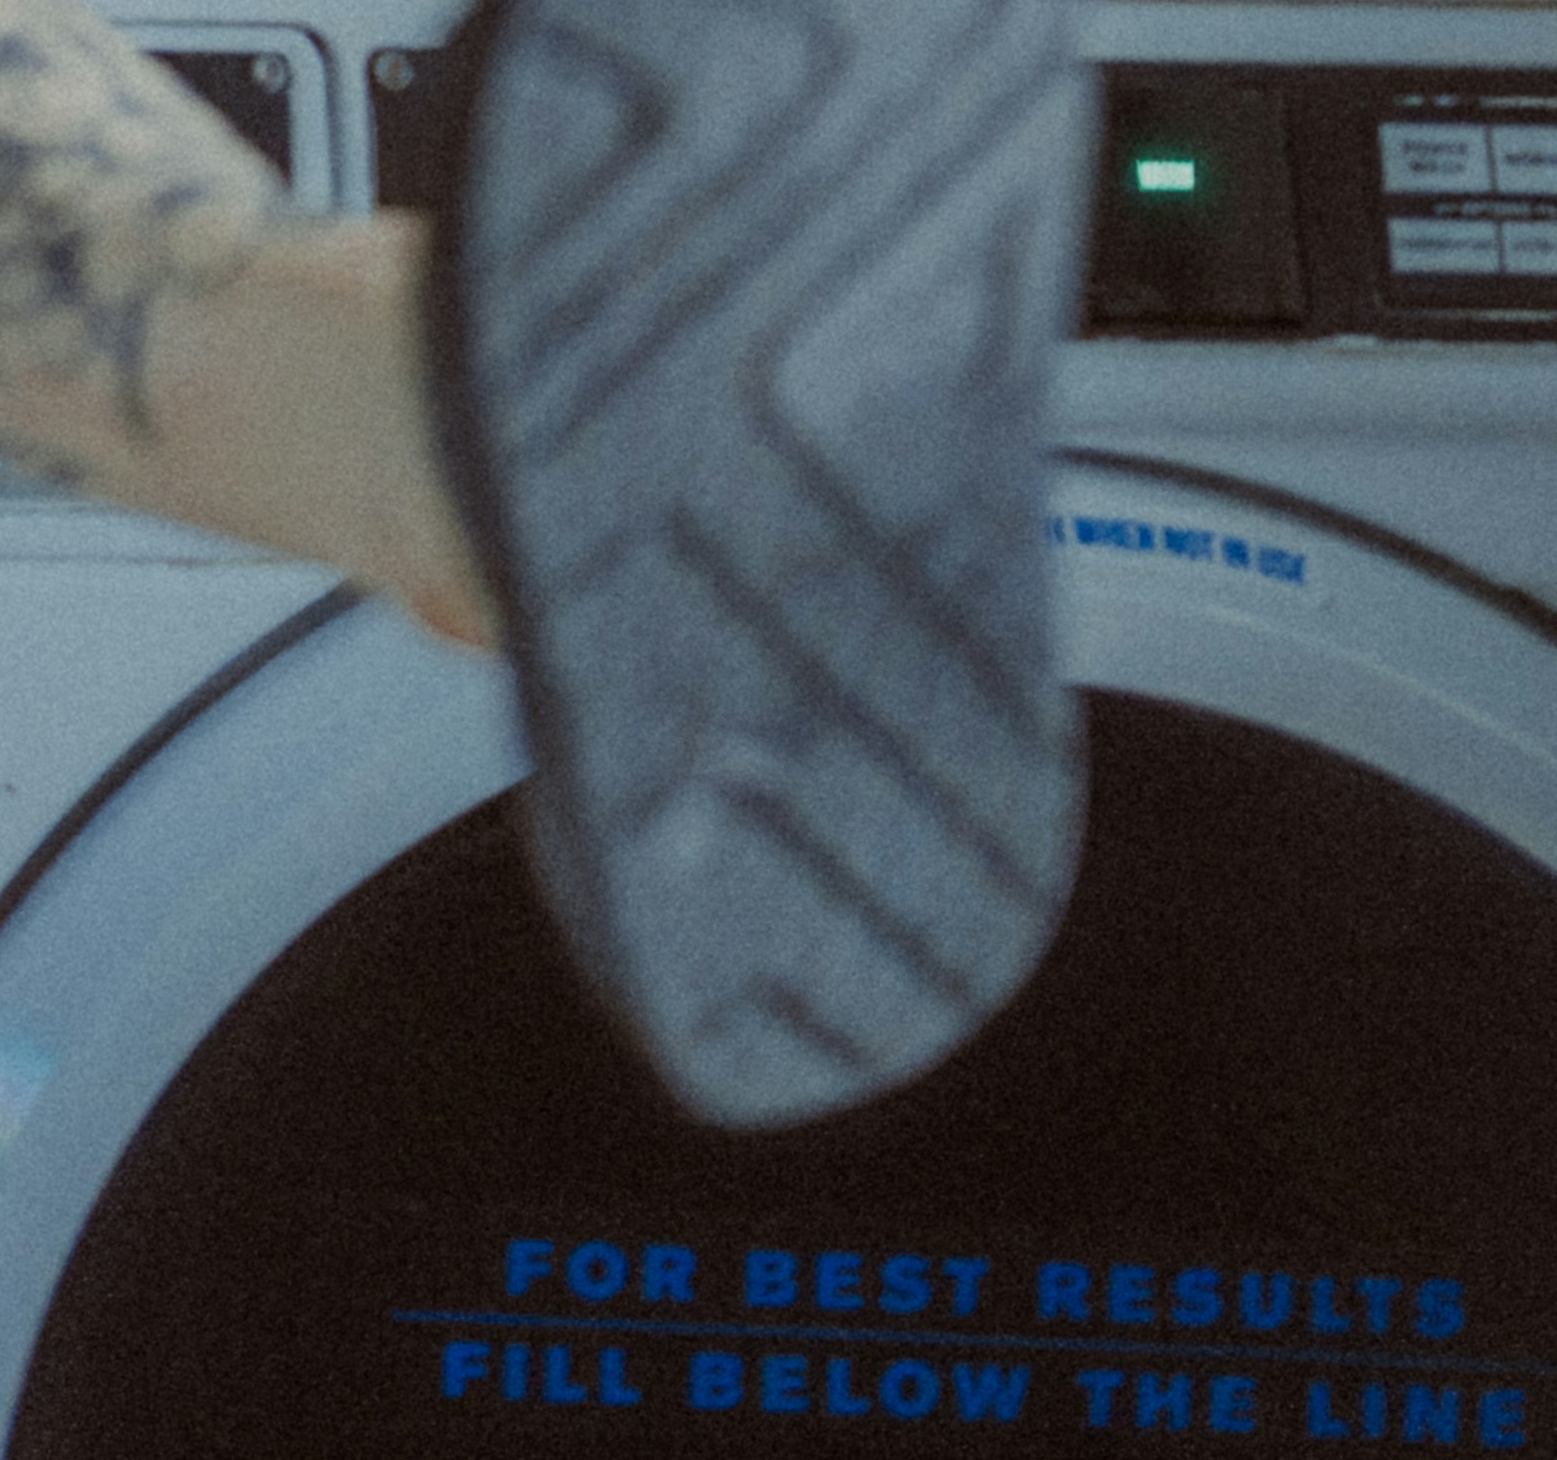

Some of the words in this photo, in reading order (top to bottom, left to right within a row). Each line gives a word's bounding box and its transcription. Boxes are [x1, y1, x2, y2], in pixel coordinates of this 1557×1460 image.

[505, 1238, 697, 1303] FOR
[744, 1249, 989, 1316] BEST
[1037, 1261, 1464, 1339] RESULTS
[441, 1340, 642, 1406] FILL
[688, 1351, 1030, 1422] BELOW
[1078, 1369, 1256, 1433] THE
[1307, 1382, 1524, 1447] LINE
